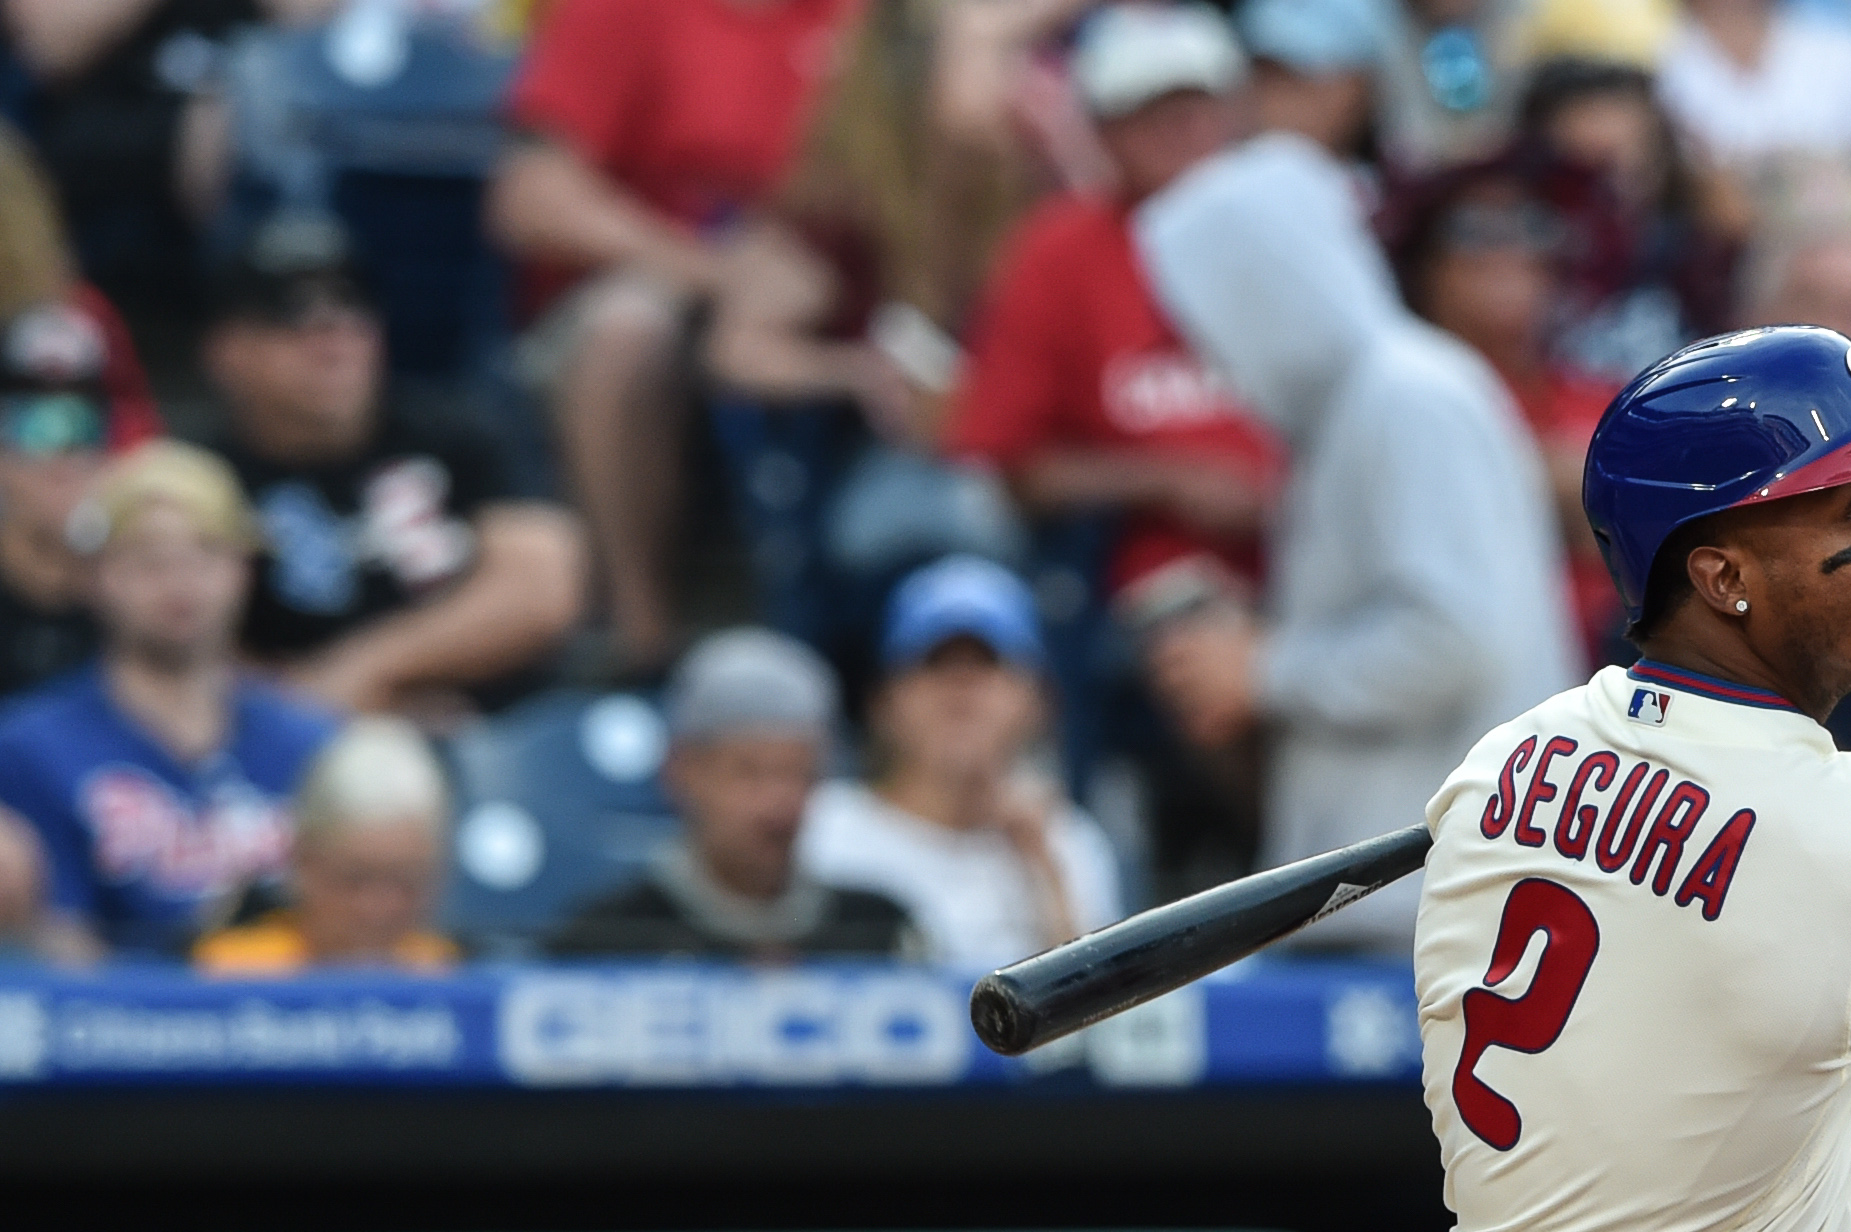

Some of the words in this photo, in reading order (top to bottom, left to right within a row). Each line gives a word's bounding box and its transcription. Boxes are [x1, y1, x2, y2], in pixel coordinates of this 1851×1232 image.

[1480, 735, 1756, 921] SEGURA
[496, 970, 970, 1086] GEICO
[1452, 878, 1600, 1151] 2
